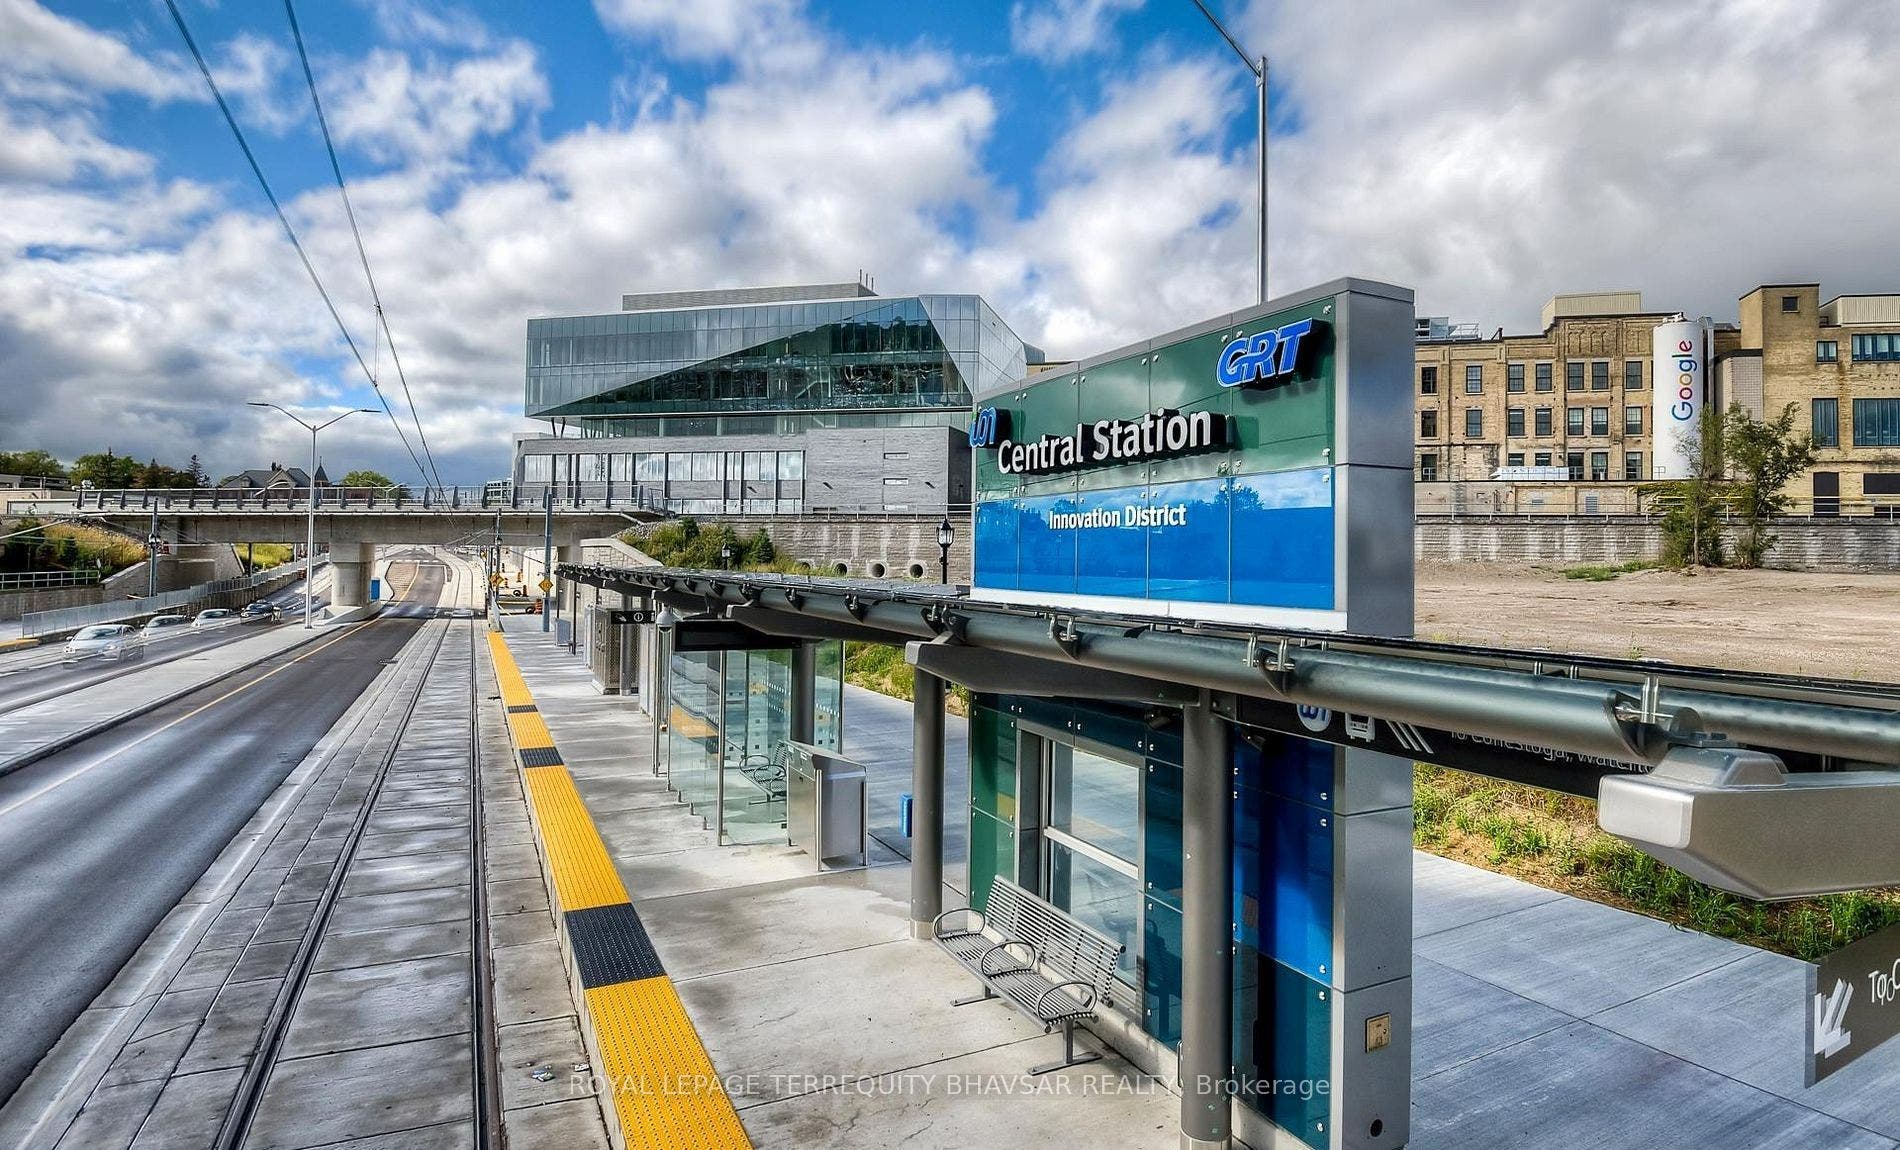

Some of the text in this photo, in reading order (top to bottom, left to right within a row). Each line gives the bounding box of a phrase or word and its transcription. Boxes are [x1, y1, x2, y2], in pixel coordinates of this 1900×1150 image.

[1217, 317, 1312, 387] GRT
[1671, 340, 1697, 421] Google
[998, 407, 1211, 474] Central Station
[1049, 503, 1187, 529] Innovation District
